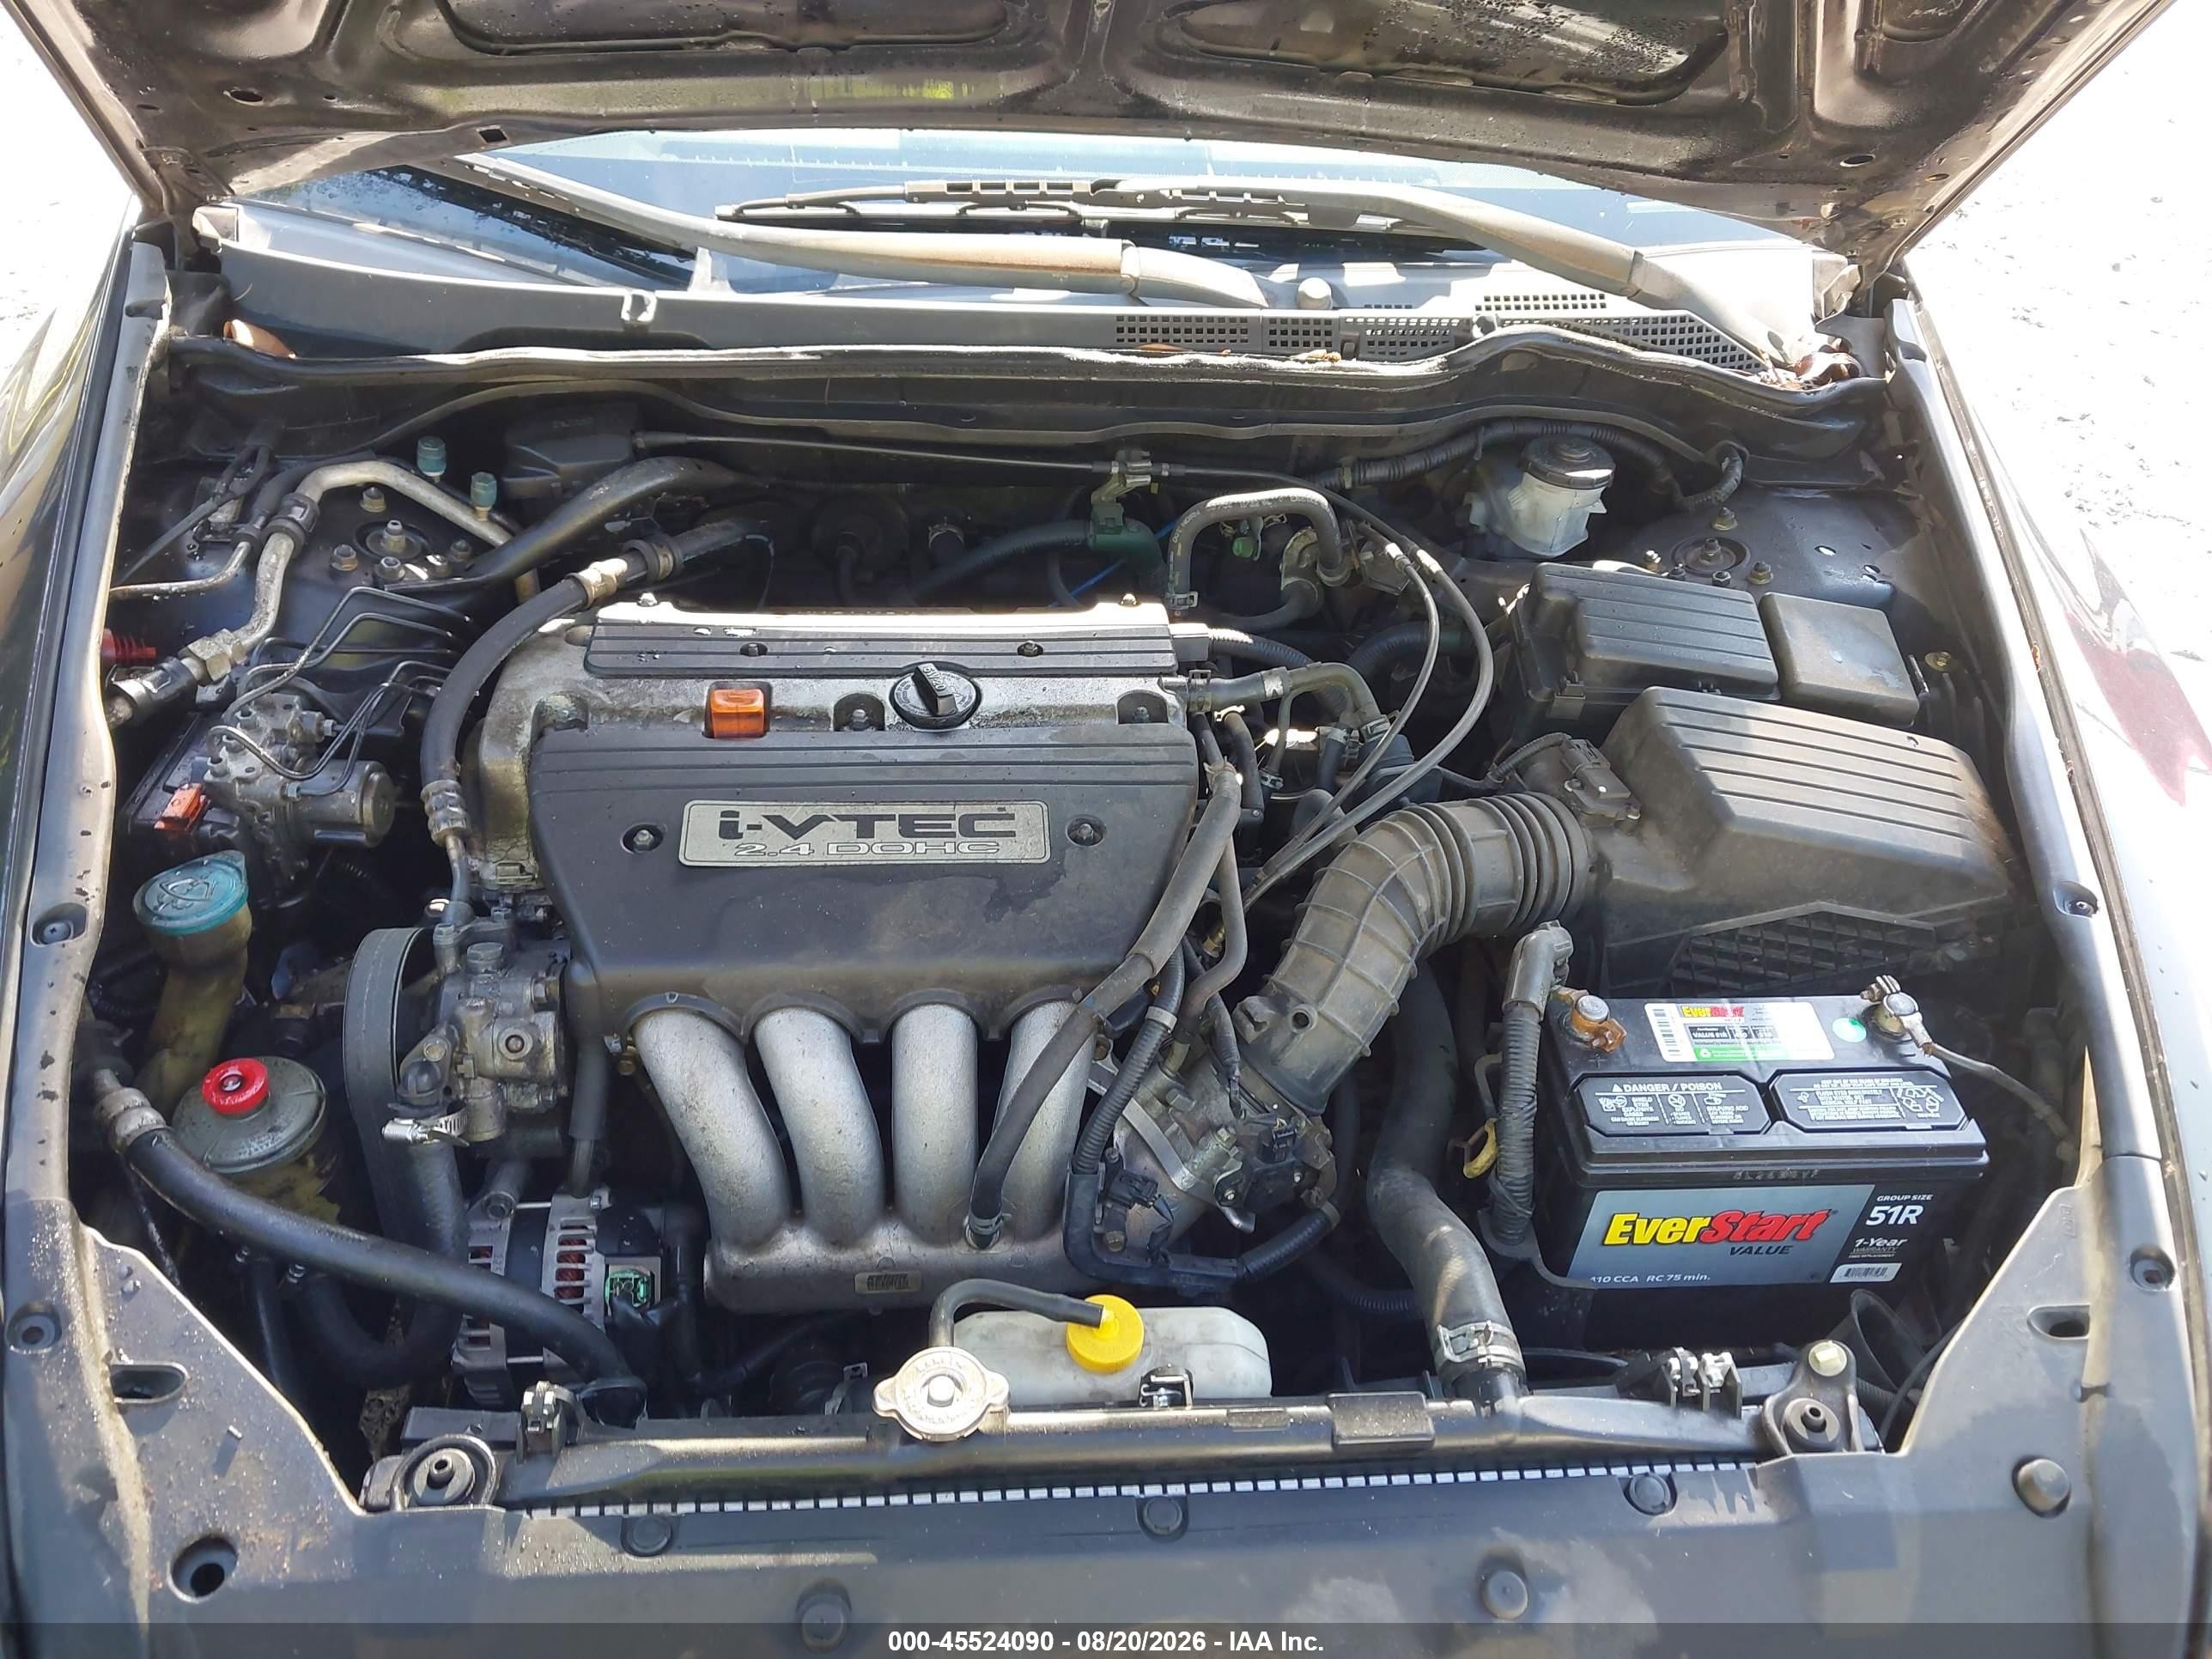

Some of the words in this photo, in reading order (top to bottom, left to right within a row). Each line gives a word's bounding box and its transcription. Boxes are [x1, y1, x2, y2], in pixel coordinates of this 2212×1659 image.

[718, 810, 1017, 840] i-VTEC
[734, 842, 815, 857] 2.4
[826, 841, 1000, 855] DOHC
[1623, 1084, 1670, 1092] DANGER
[1680, 1082, 1723, 1091] POISON
[1865, 1205, 1924, 1225] 51R
[1602, 1209, 1832, 1246] EverStart
[1855, 1237, 1908, 1247] 1-Year
[1729, 1245, 1793, 1255] VALUE
[1683, 1273, 1711, 1281] min.
